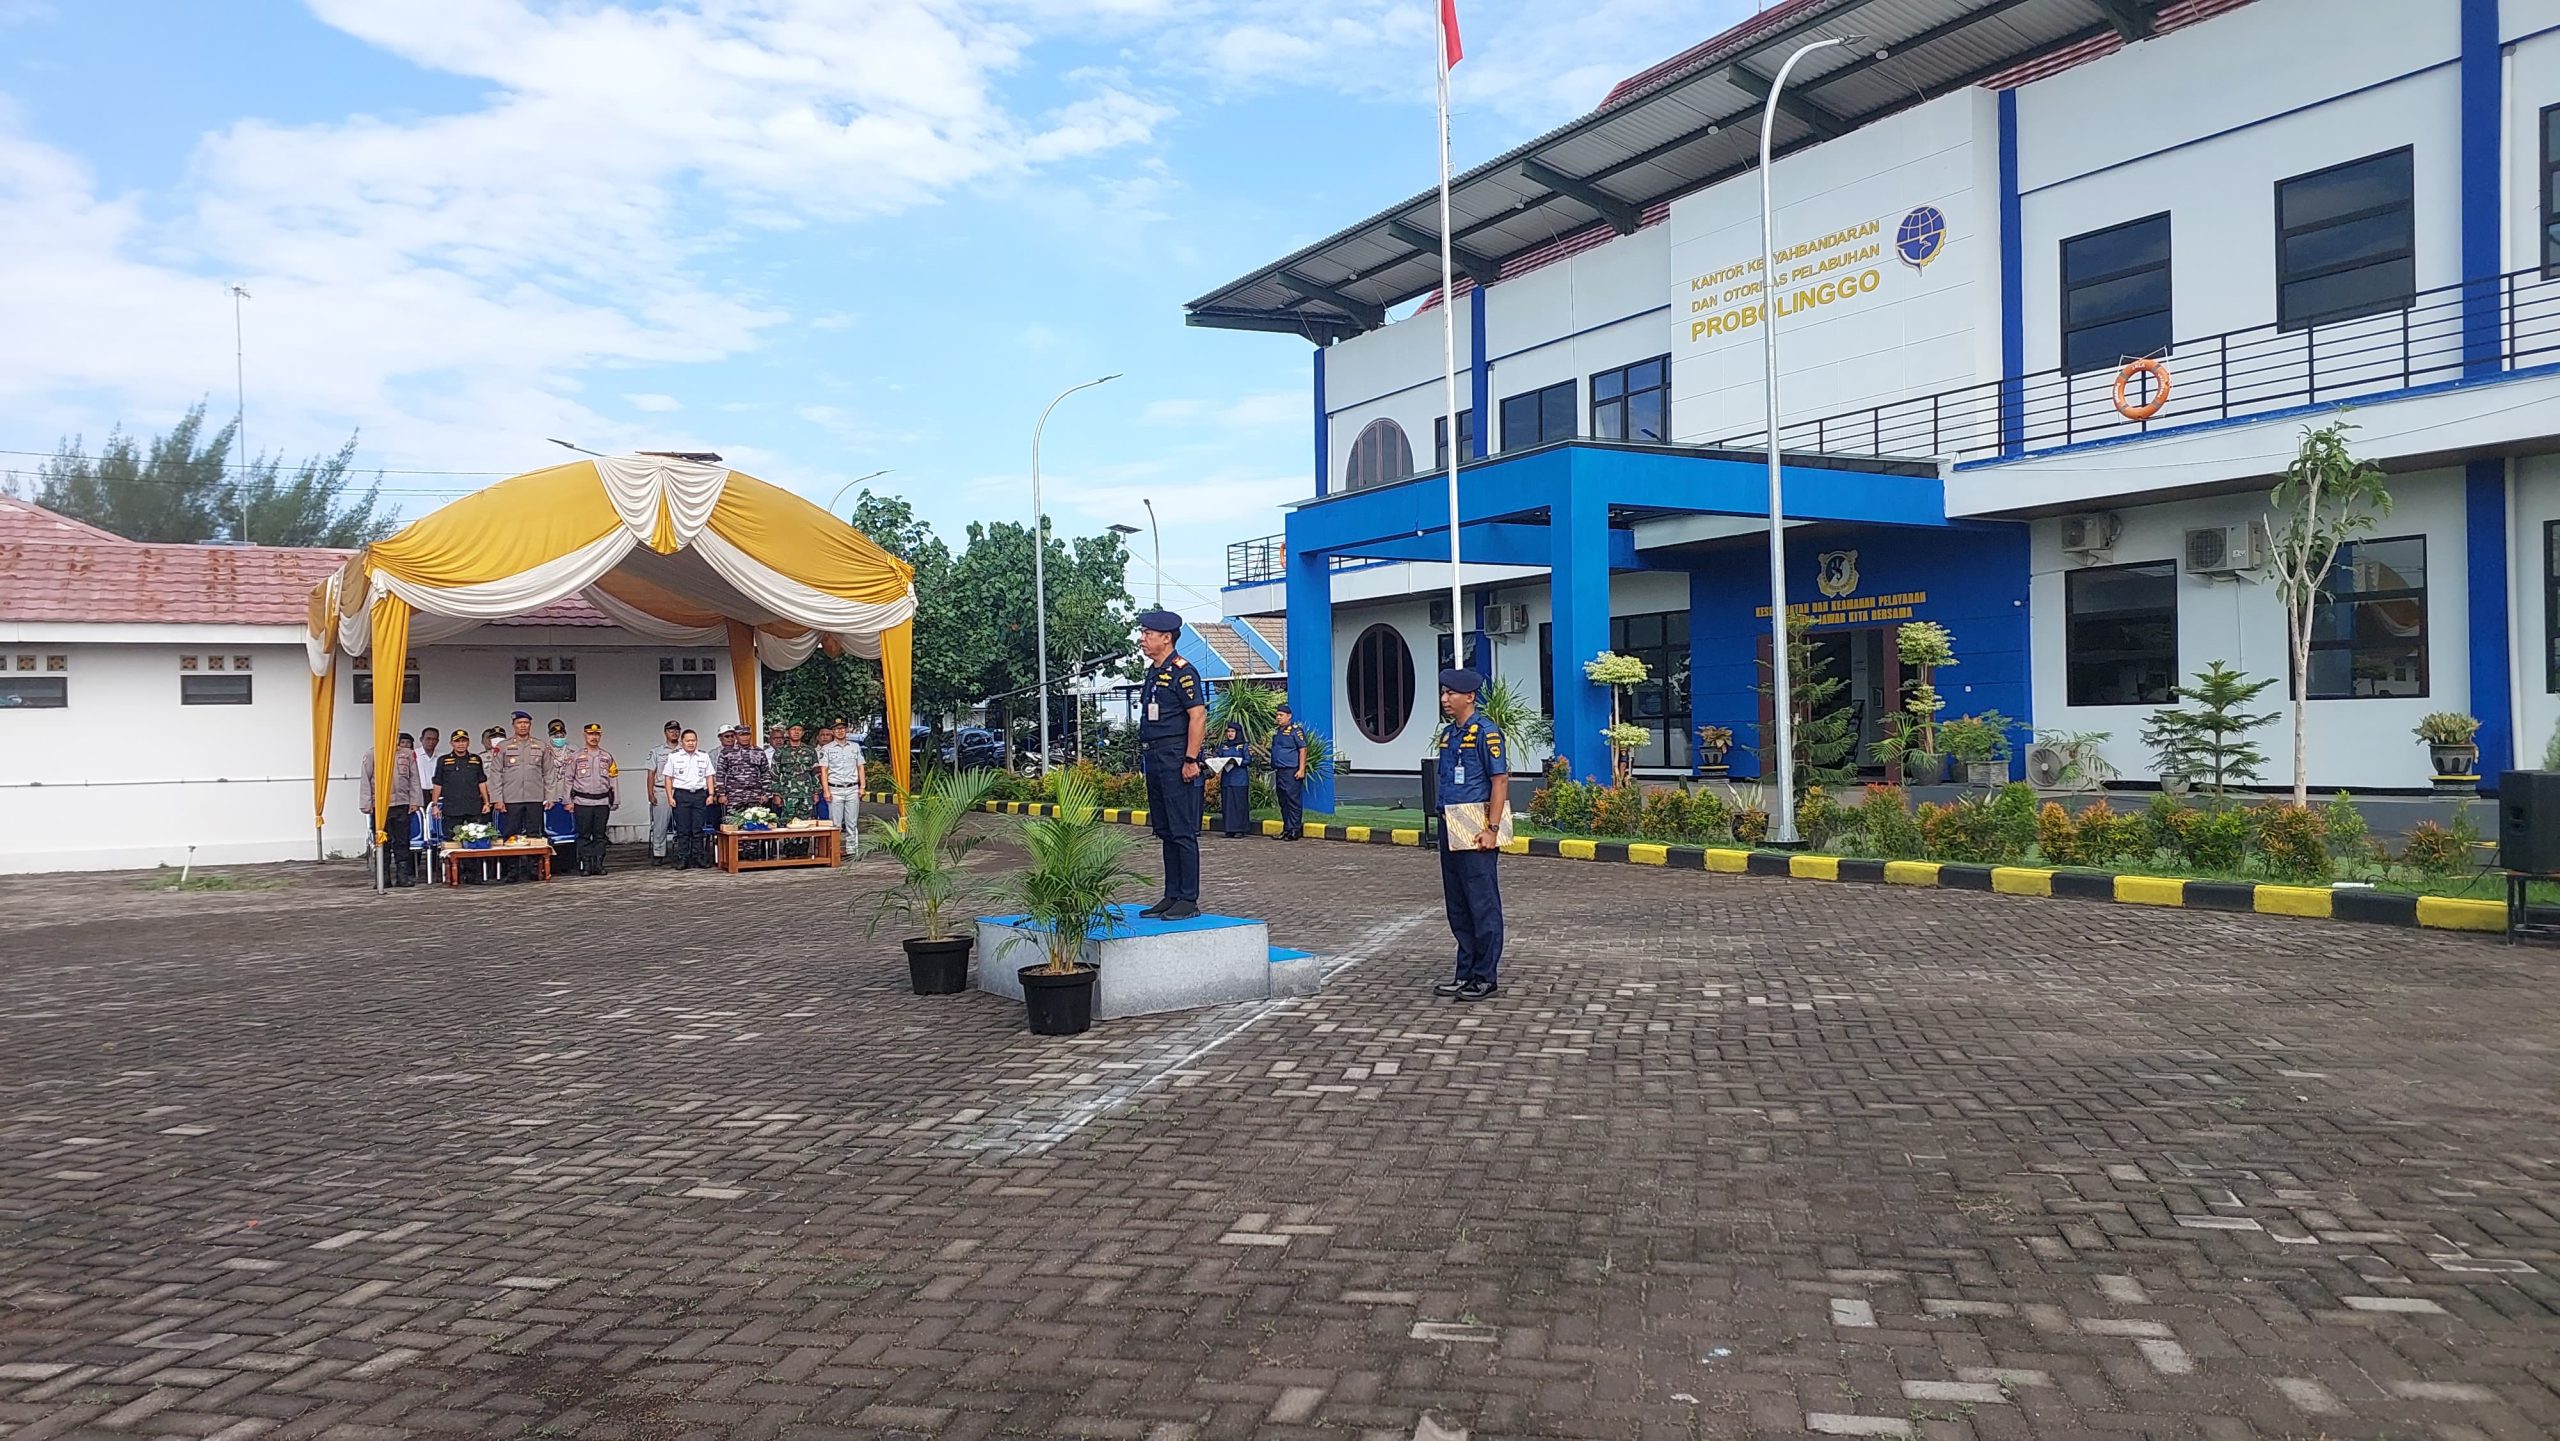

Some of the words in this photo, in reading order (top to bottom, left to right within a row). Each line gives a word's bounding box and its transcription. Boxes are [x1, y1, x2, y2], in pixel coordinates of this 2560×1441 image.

[1691, 264, 1744, 291] KANTOR
[1747, 219, 1880, 274] KEYAHBANDARAN
[1691, 294, 1718, 313] DAN
[1723, 272, 1788, 303] OTORIAS
[1791, 243, 1880, 282] PELABUHAN
[1872, 607, 1912, 620] BERSAMA
